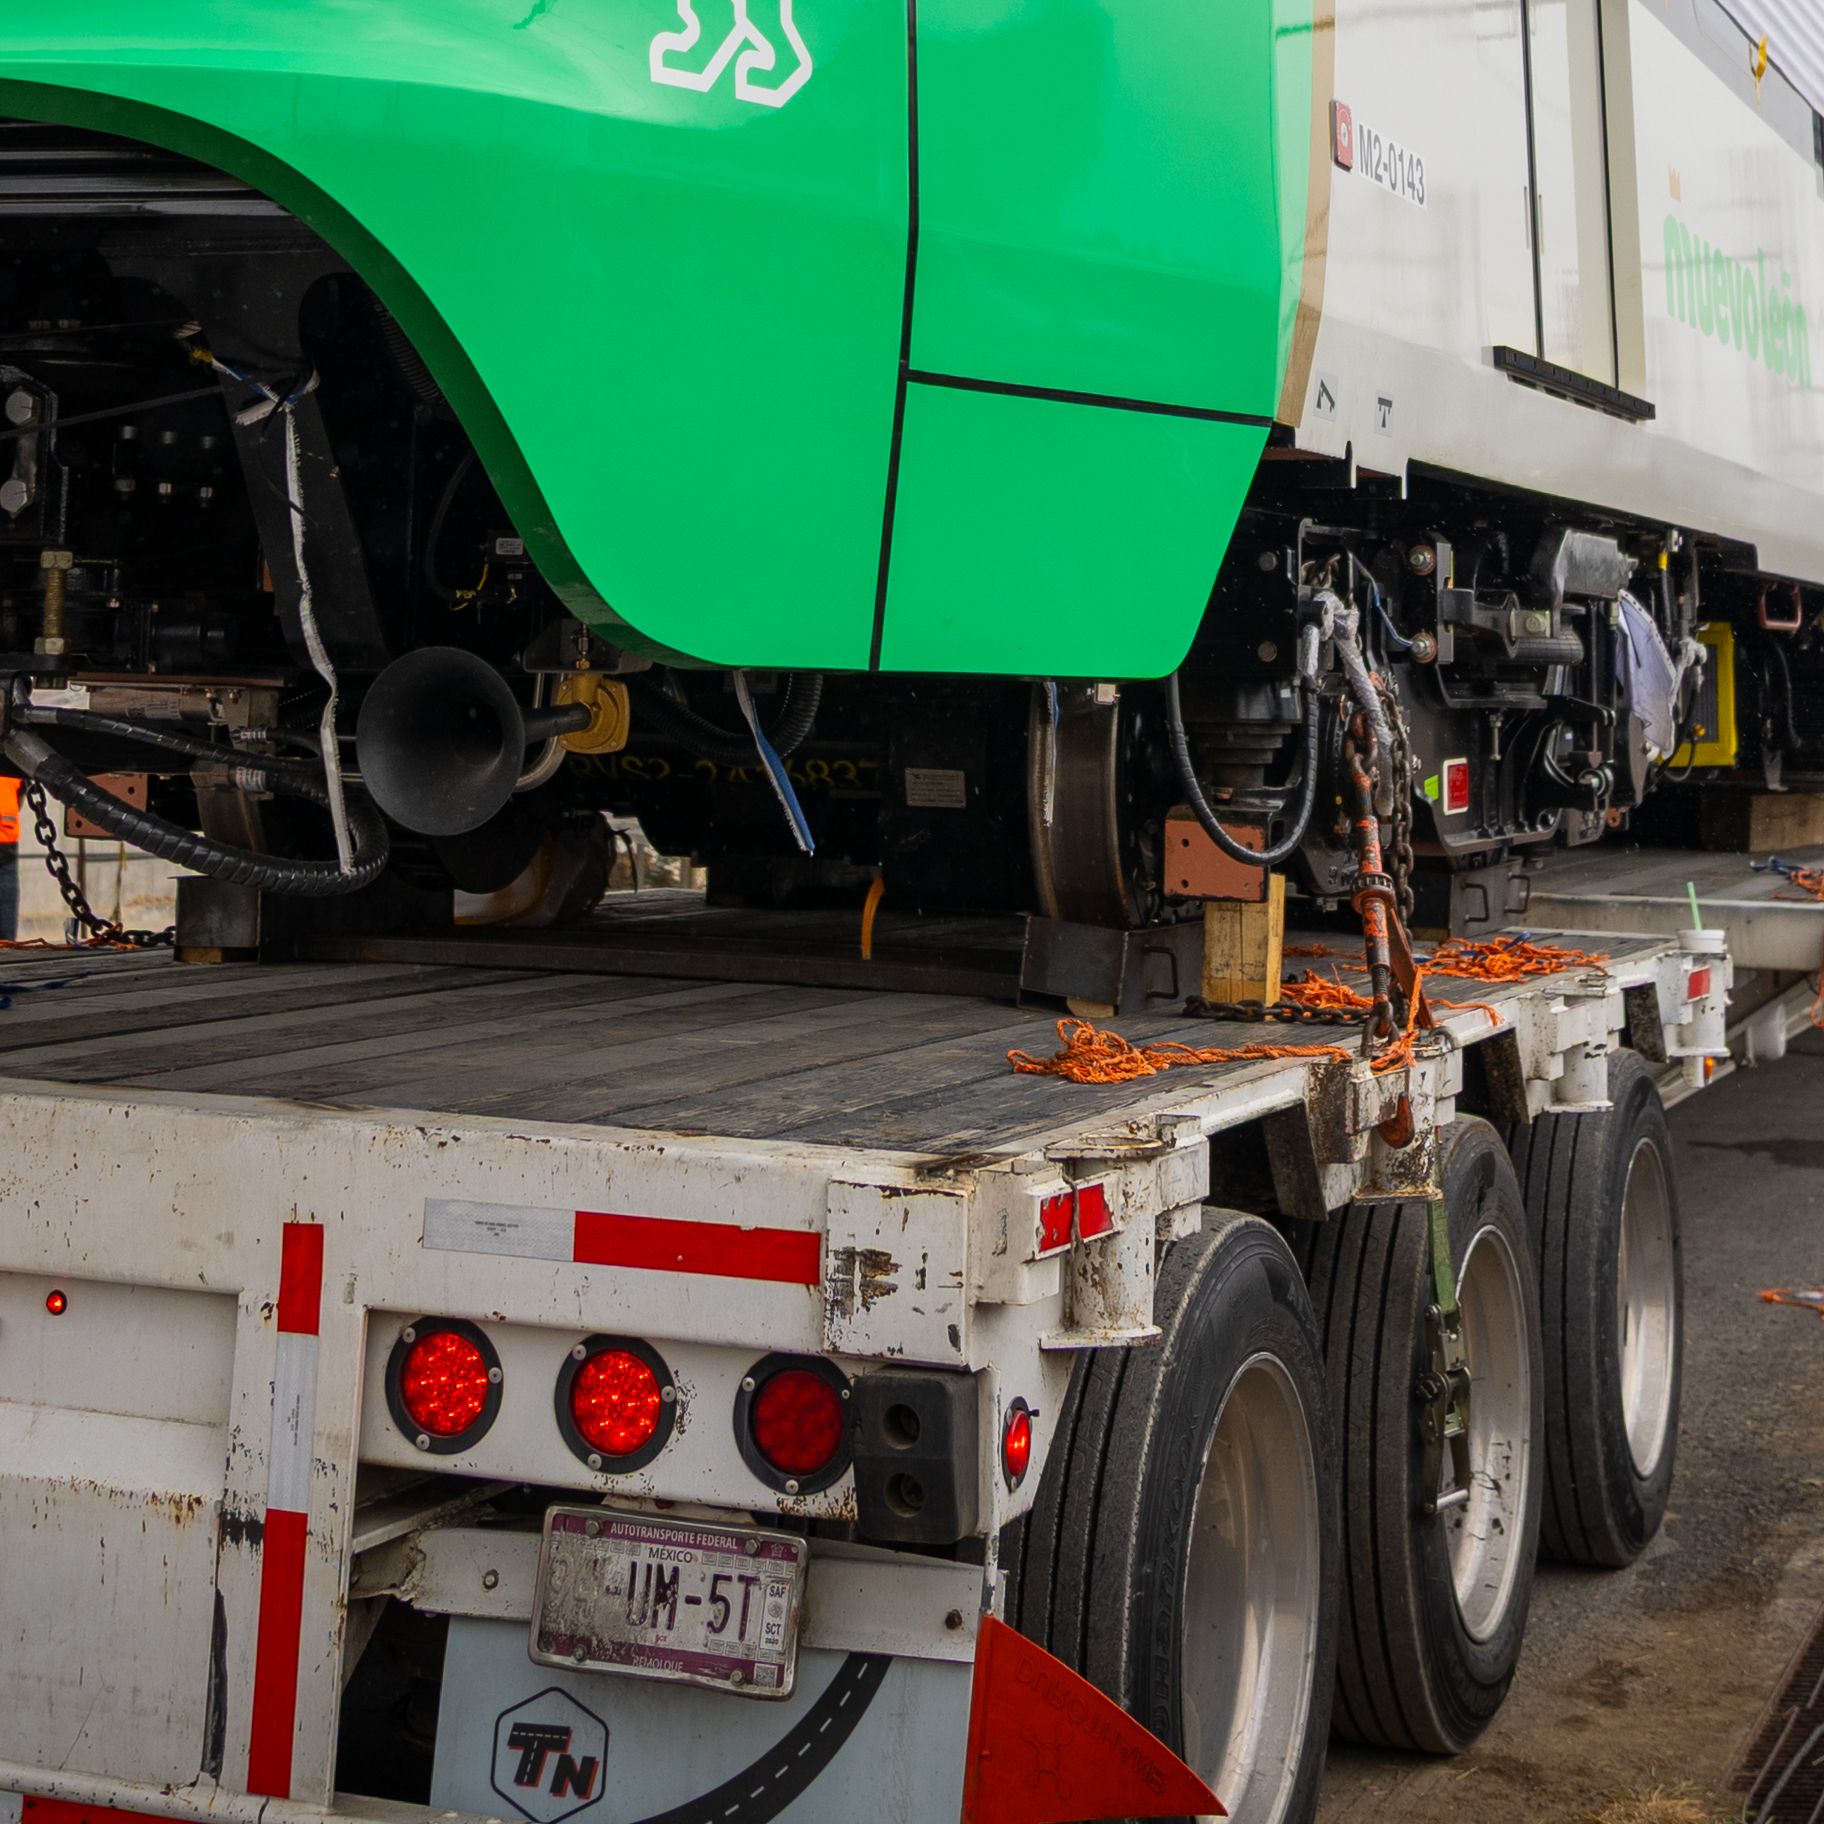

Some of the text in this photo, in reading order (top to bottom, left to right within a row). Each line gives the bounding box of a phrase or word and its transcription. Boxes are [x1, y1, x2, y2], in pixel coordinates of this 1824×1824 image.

[1358, 123, 1425, 206] M2-0143
[610, 1522, 738, 1550] AUTOTRANSPORTE FEDERAL
[764, 1622, 782, 1635] SCT
[506, 1721, 600, 1800] TN
